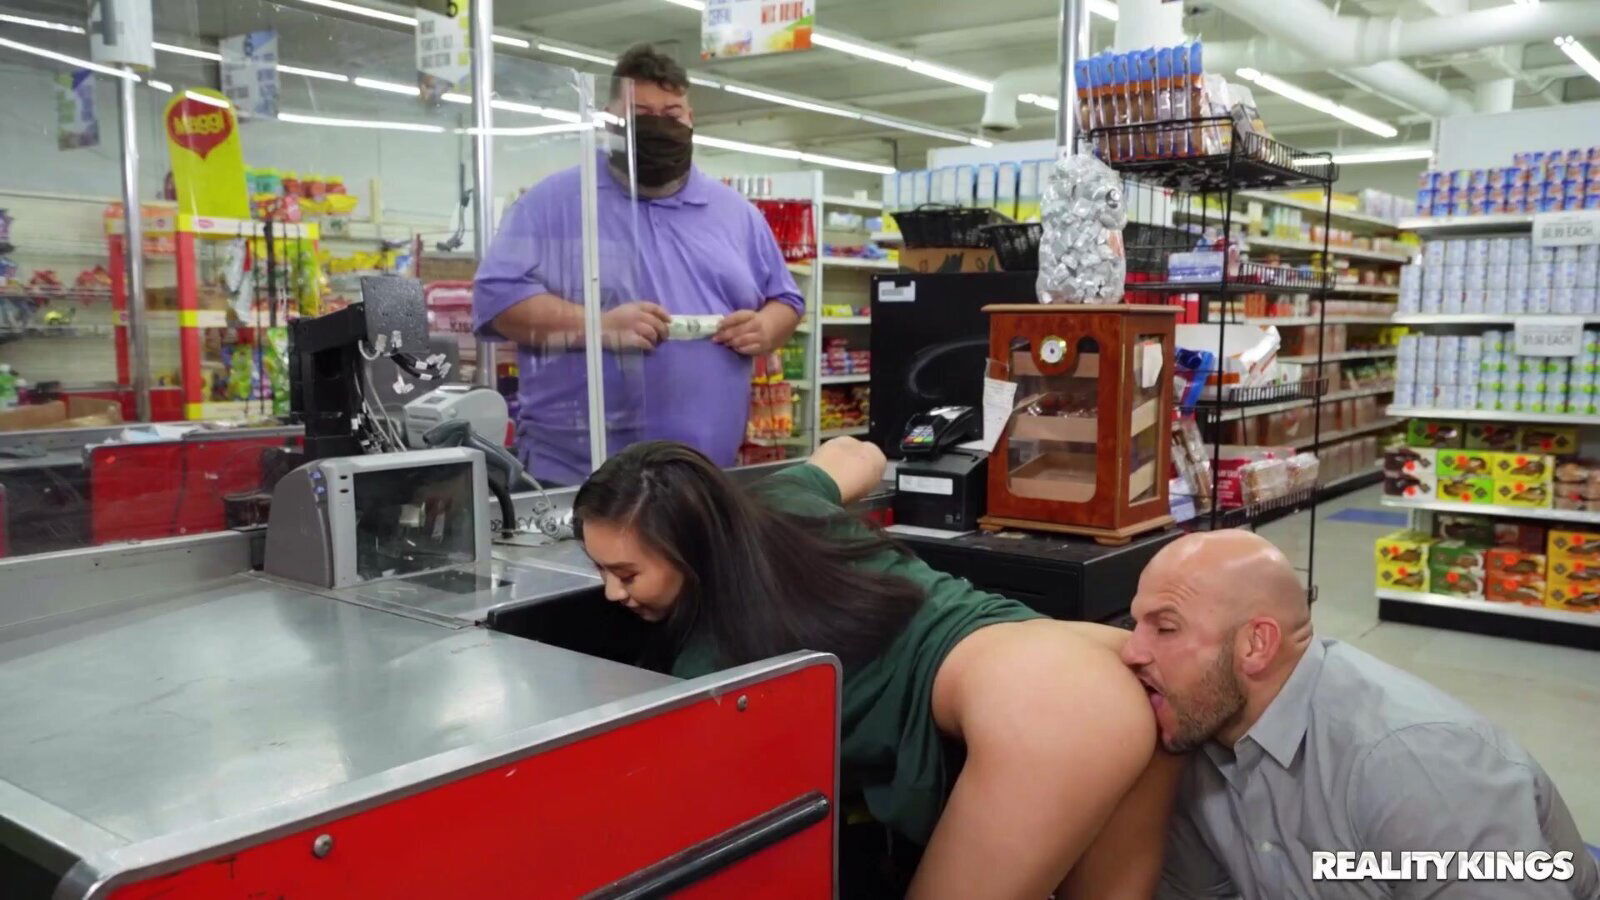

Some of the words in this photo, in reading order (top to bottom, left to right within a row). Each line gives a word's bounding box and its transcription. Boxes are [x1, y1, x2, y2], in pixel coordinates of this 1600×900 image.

[173, 112, 225, 136] Maggi
[1566, 225, 1593, 238] EACH
[1547, 334, 1573, 346] EACH
